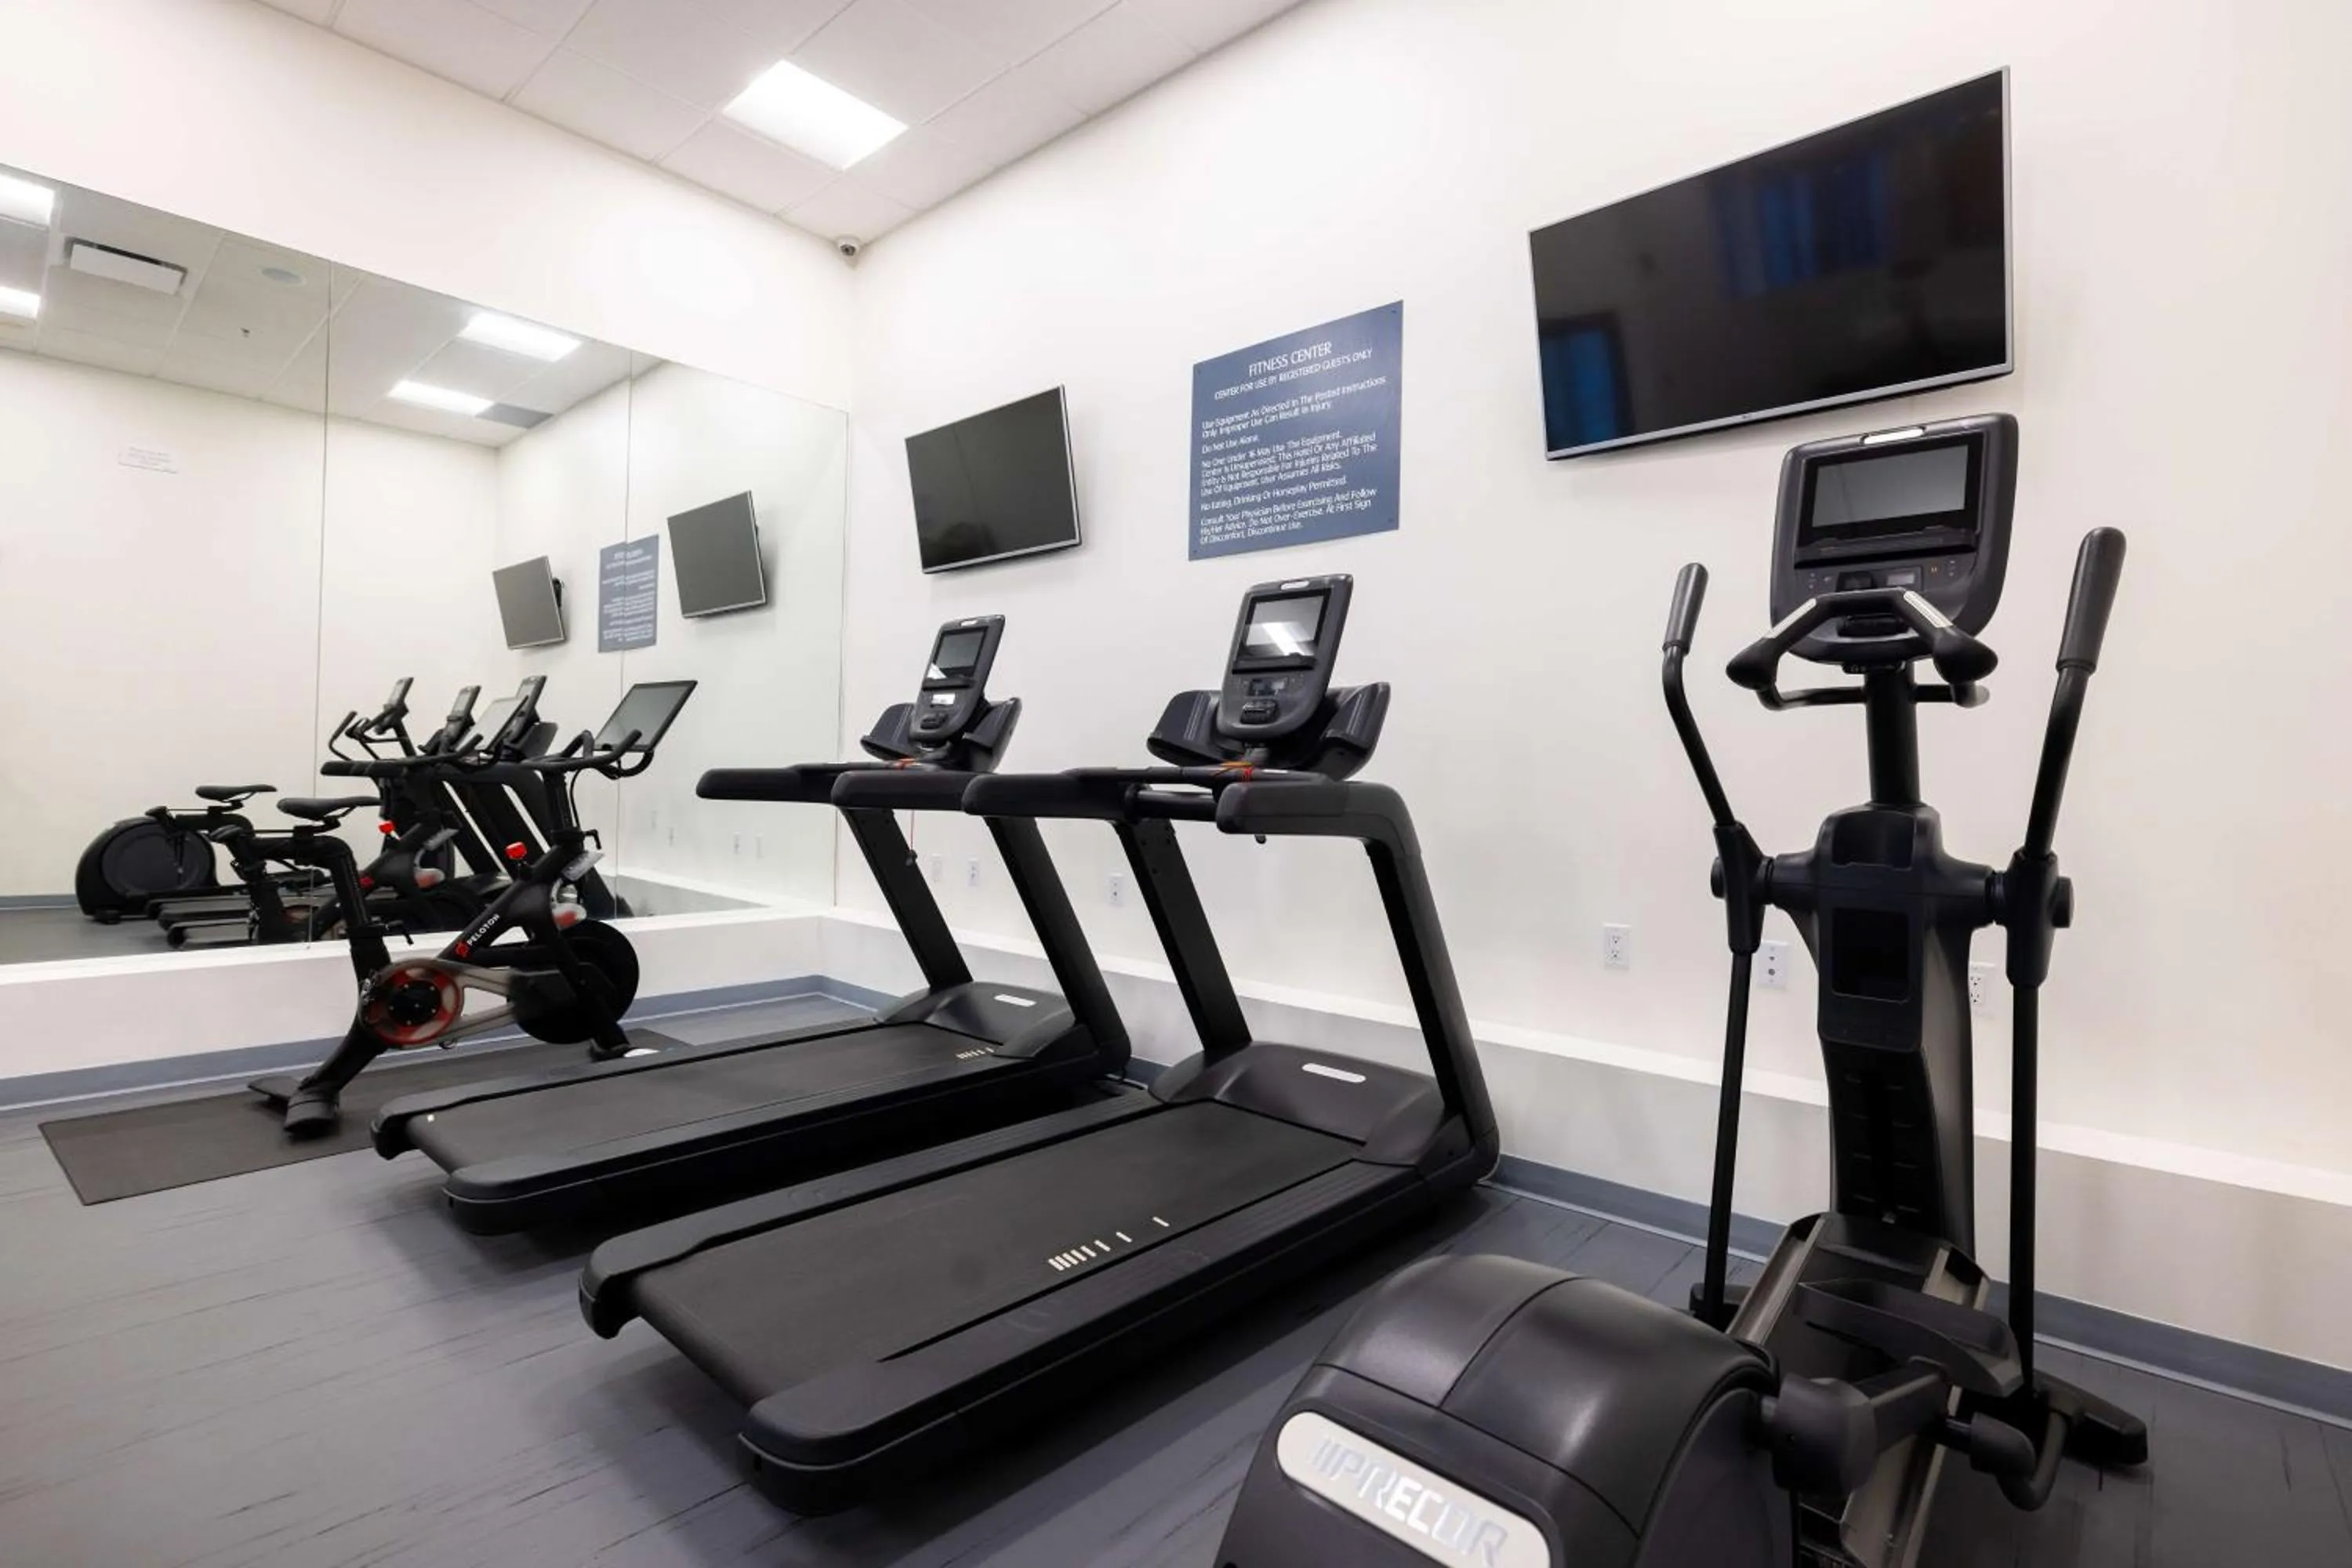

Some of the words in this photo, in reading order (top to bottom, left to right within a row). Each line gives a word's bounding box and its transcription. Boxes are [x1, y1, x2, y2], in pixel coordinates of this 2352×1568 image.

[1249, 354, 1288, 376] FITNESS
[1290, 341, 1331, 365] CENTER
[1214, 385, 1239, 399] CENTER
[1240, 381, 1254, 392] FOR
[1255, 377, 1267, 388] USE
[1269, 374, 1277, 385] BY
[1279, 362, 1321, 382] REGISTERED
[1323, 354, 1350, 370] GUESTS
[1352, 348, 1372, 362] ONLY
[1203, 419, 1214, 429] Use
[1215, 410, 1250, 427] Equipment
[1251, 408, 1260, 417] As
[1261, 400, 1290, 415] Directed
[1292, 397, 1299, 407] In
[1301, 394, 1312, 405] The
[1315, 387, 1341, 401] Posted
[1265, 413, 1279, 423] Can
[1279, 408, 1299, 419] Result
[1202, 444, 1212, 453] Do
[1214, 441, 1225, 451] Not
[1225, 437, 1238, 448] Use
[1202, 459, 1211, 468] No
[1213, 456, 1225, 466] One
[1272, 443, 1285, 452] Use
[1287, 439, 1300, 449] The
[1279, 451, 1293, 460] This
[1294, 447, 1312, 457] Hotel
[1314, 445, 1323, 453] Or
[1341, 431, 1376, 447] Affiliated
[1227, 472, 1239, 481] Not
[1351, 446, 1359, 456] To
[1363, 442, 1377, 453] The
[1311, 465, 1319, 474] All
[1233, 492, 1261, 506] Drinking
[1262, 491, 1270, 499] Or
[1241, 506, 1272, 519] Physician
[1334, 492, 1350, 502] And
[1351, 487, 1377, 499] Follow
[1260, 515, 1272, 524] Not
[1336, 501, 1352, 512] First
[1354, 498, 1371, 511] Sign
[1248, 523, 1287, 536] Discontinue
[466, 913, 500, 946] PELOTON
[1329, 1447, 1510, 1567] PRECOR
